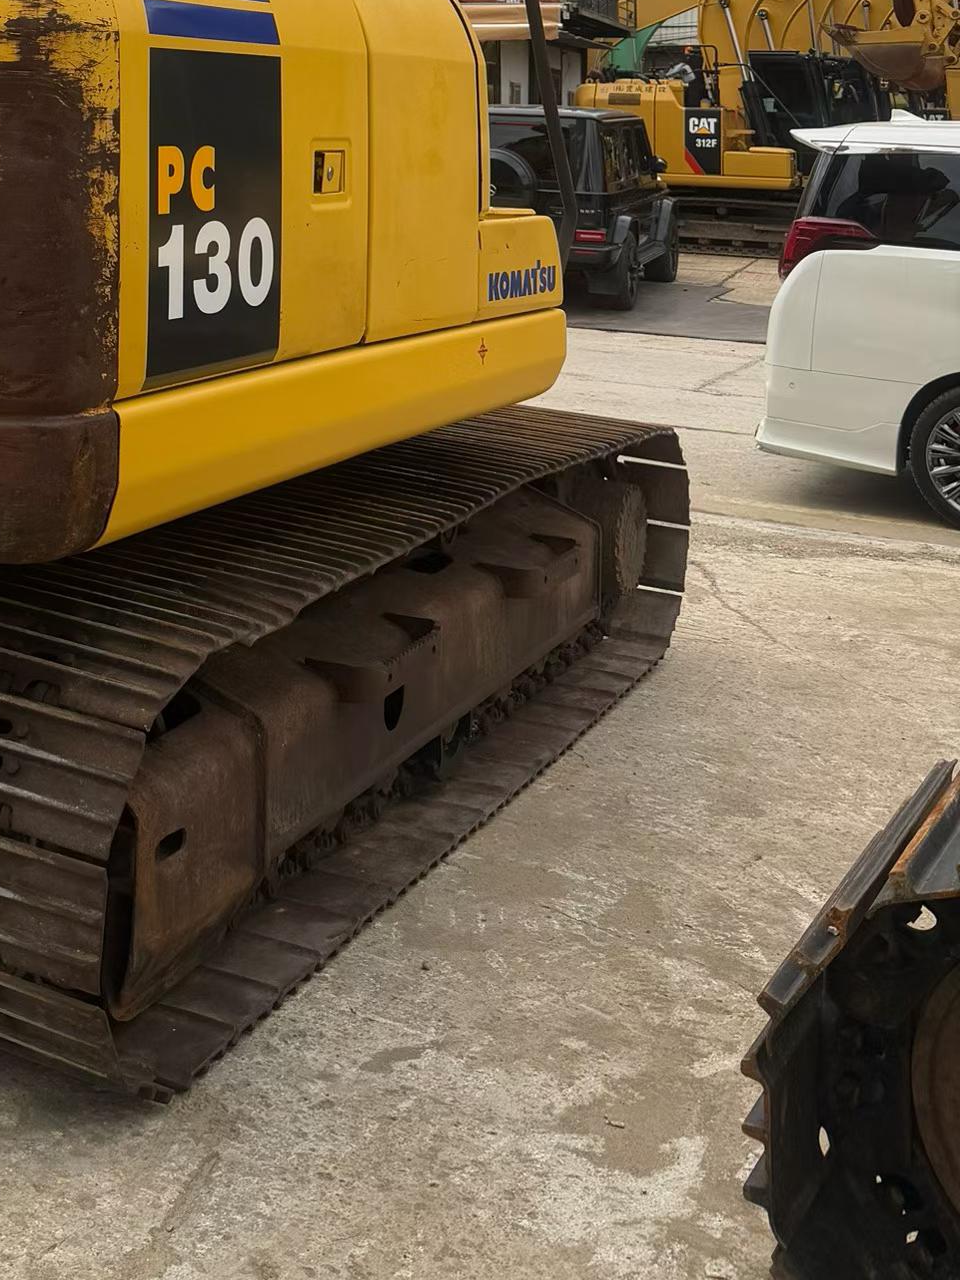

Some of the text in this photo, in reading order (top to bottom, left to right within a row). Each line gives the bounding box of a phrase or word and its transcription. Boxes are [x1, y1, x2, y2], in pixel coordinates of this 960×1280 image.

[688, 117, 717, 134] CAT
[695, 138, 718, 148] 312F
[157, 145, 216, 215] PC
[157, 217, 275, 320] 130
[488, 259, 556, 302] KOMATSU
